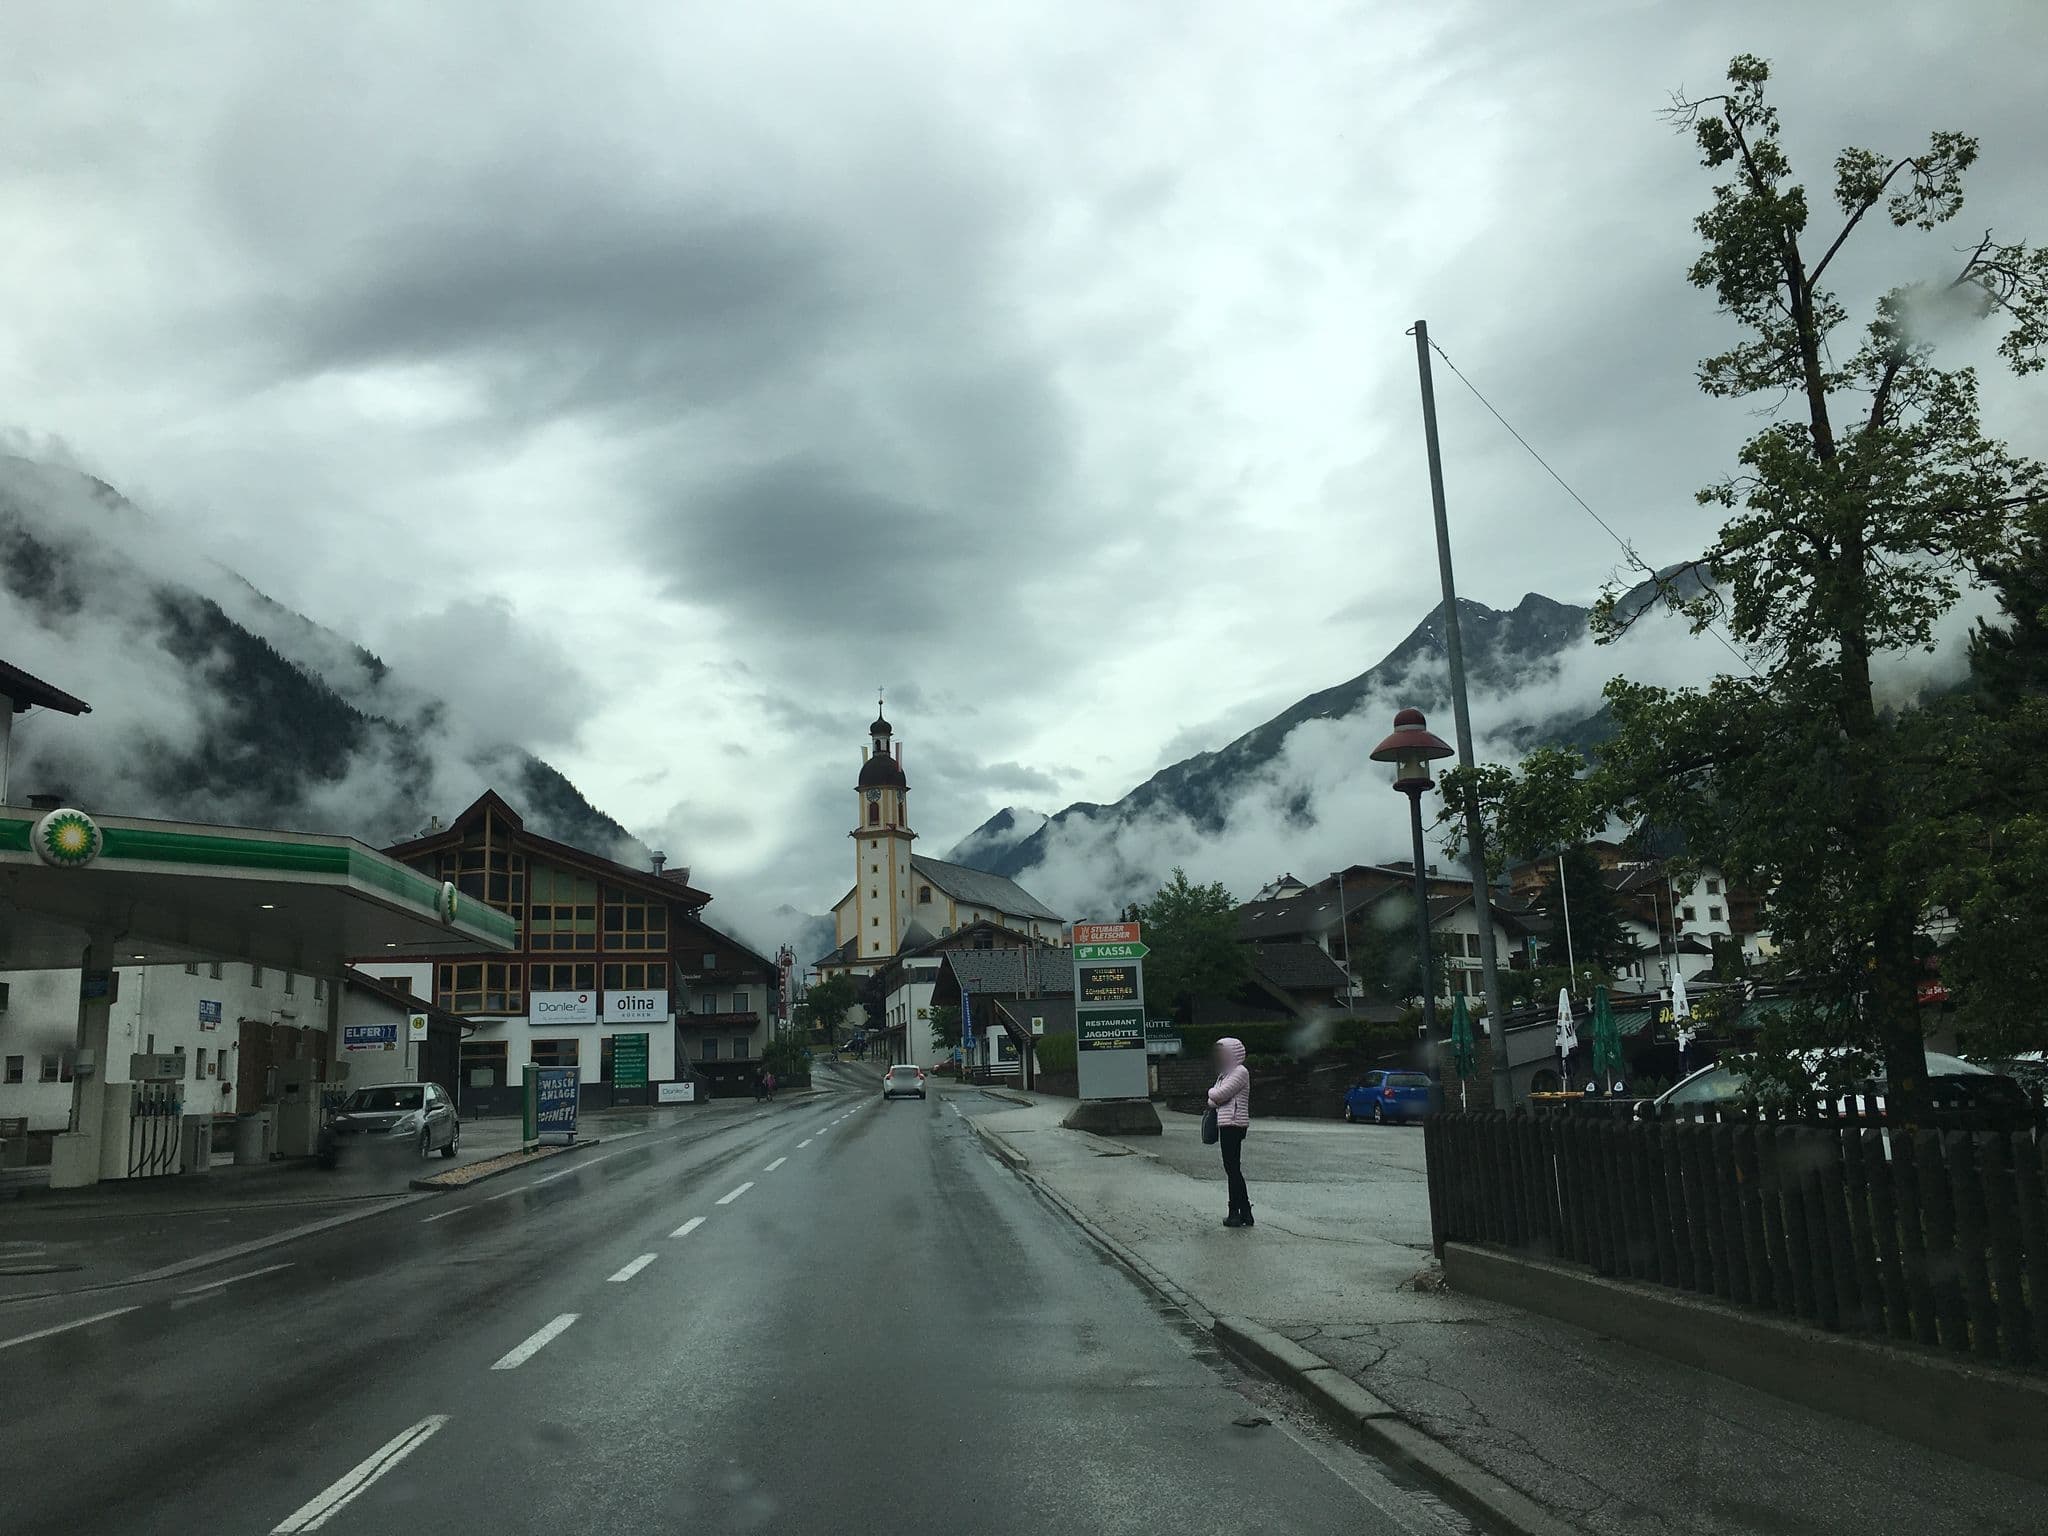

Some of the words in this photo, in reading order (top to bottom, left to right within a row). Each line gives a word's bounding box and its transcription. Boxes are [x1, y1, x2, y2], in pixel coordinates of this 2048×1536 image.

[1097, 946, 1132, 956] KASSA
[538, 1002, 578, 1012] Danler
[617, 996, 654, 1010] olina
[1085, 1019, 1137, 1027] RESTAURANT
[345, 1028, 381, 1038] ELFER
[1084, 1030, 1139, 1039] JAGDHÜTTE
[541, 1079, 574, 1089] WASCH
[540, 1088, 575, 1100] ANLAGE
